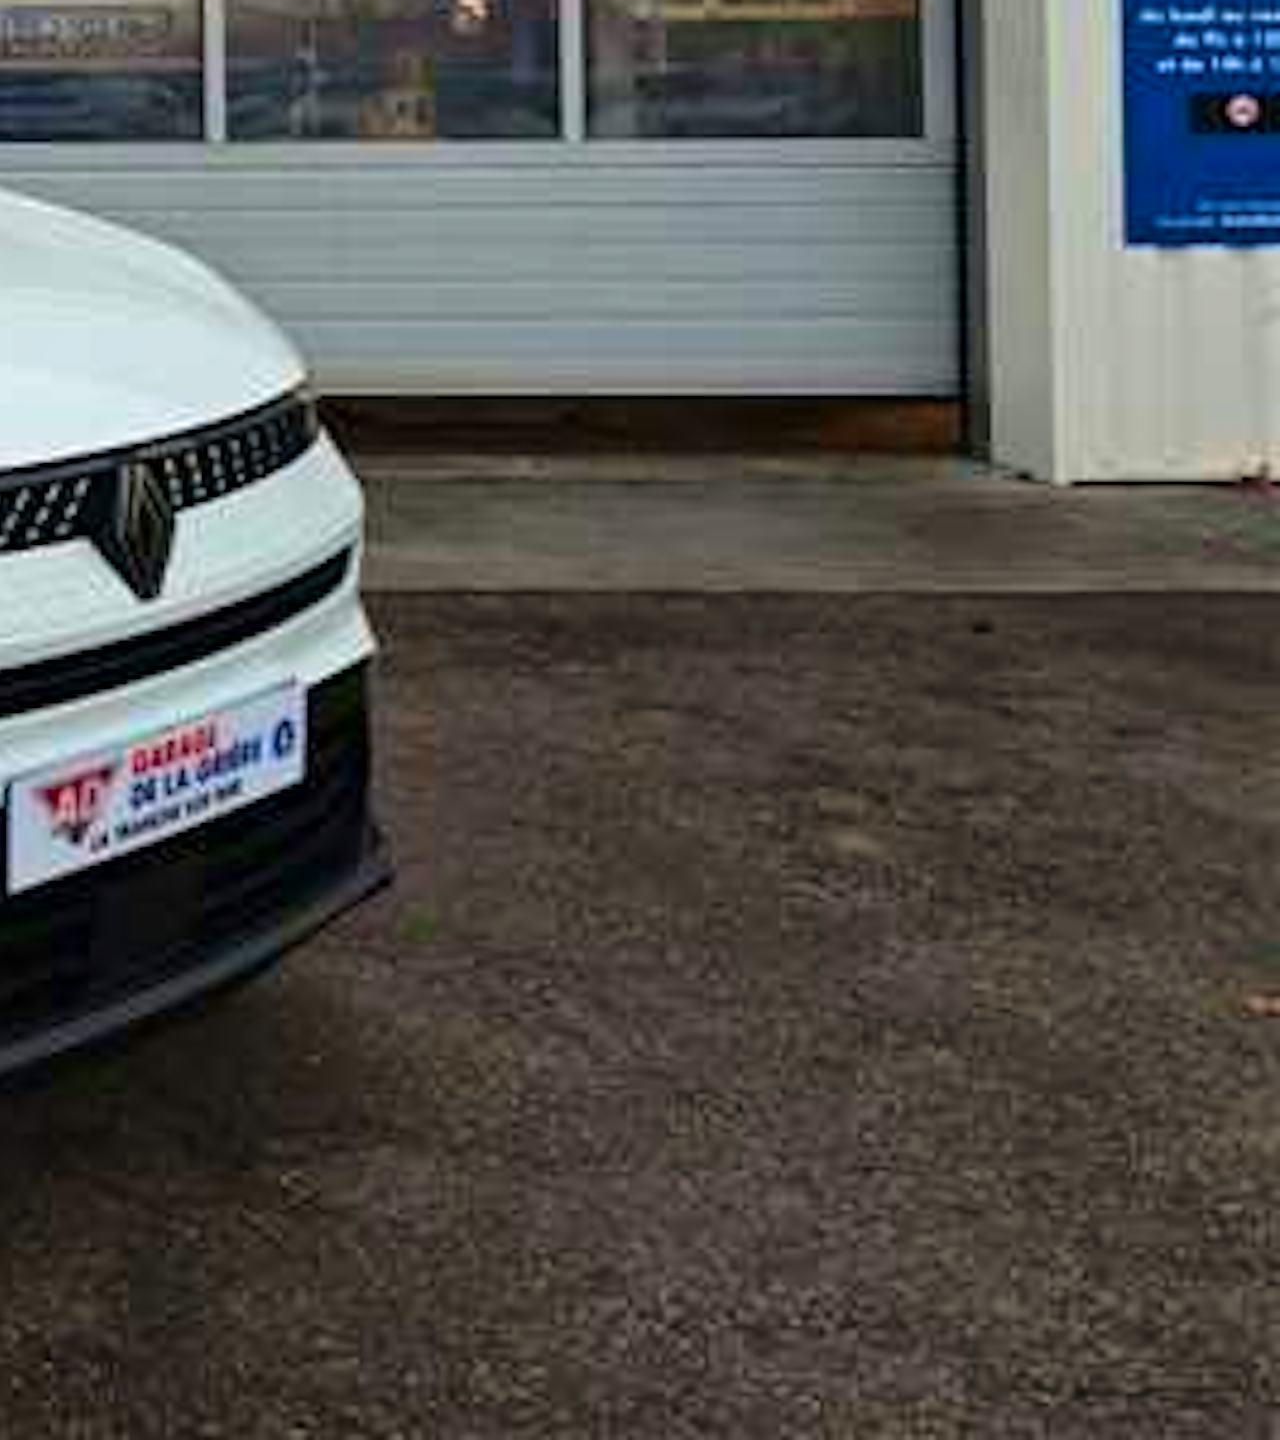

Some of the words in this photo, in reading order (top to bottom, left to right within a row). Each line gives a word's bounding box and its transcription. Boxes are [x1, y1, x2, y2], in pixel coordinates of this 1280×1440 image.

[131, 720, 216, 774] GARAGE
[130, 777, 157, 808] DE
[165, 768, 189, 796] LA
